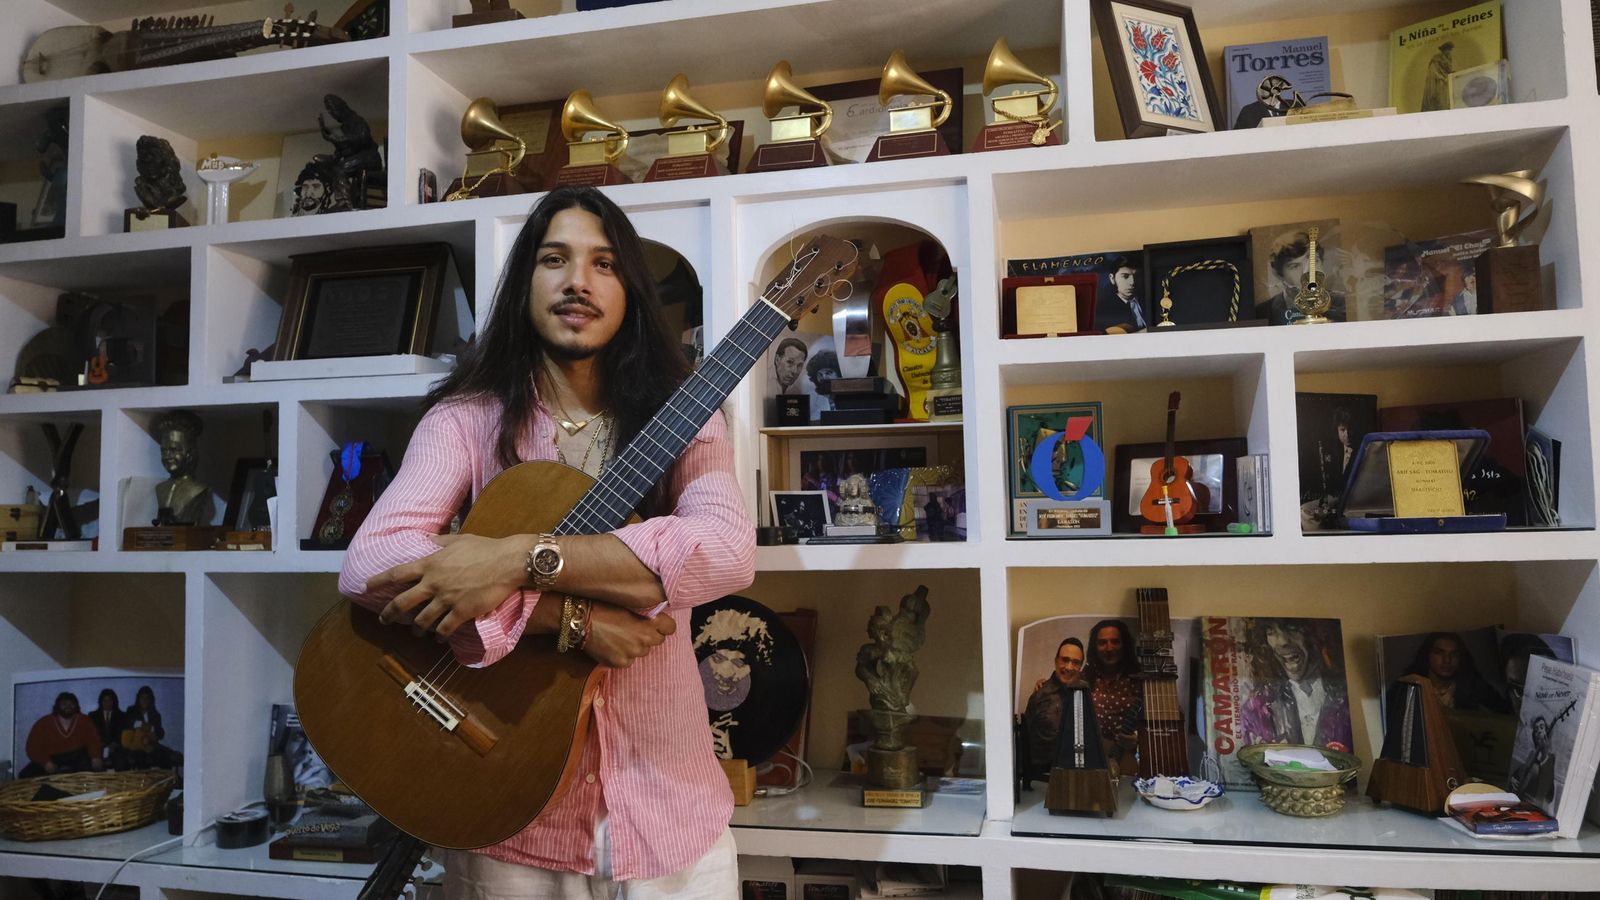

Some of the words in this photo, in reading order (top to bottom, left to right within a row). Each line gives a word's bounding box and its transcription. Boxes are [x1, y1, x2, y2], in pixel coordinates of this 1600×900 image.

[1408, 26, 1438, 42] Niña
[1451, 9, 1494, 29] Peines
[1282, 42, 1323, 55] Manuel
[1231, 51, 1325, 73] Torres
[1022, 256, 1104, 271] FLAMENCO
[1206, 617, 1235, 755] CAMARÓN
[1233, 694, 1242, 727] TIEMPO
[1235, 729, 1242, 740] EL
[320, 822, 341, 833] Vega
